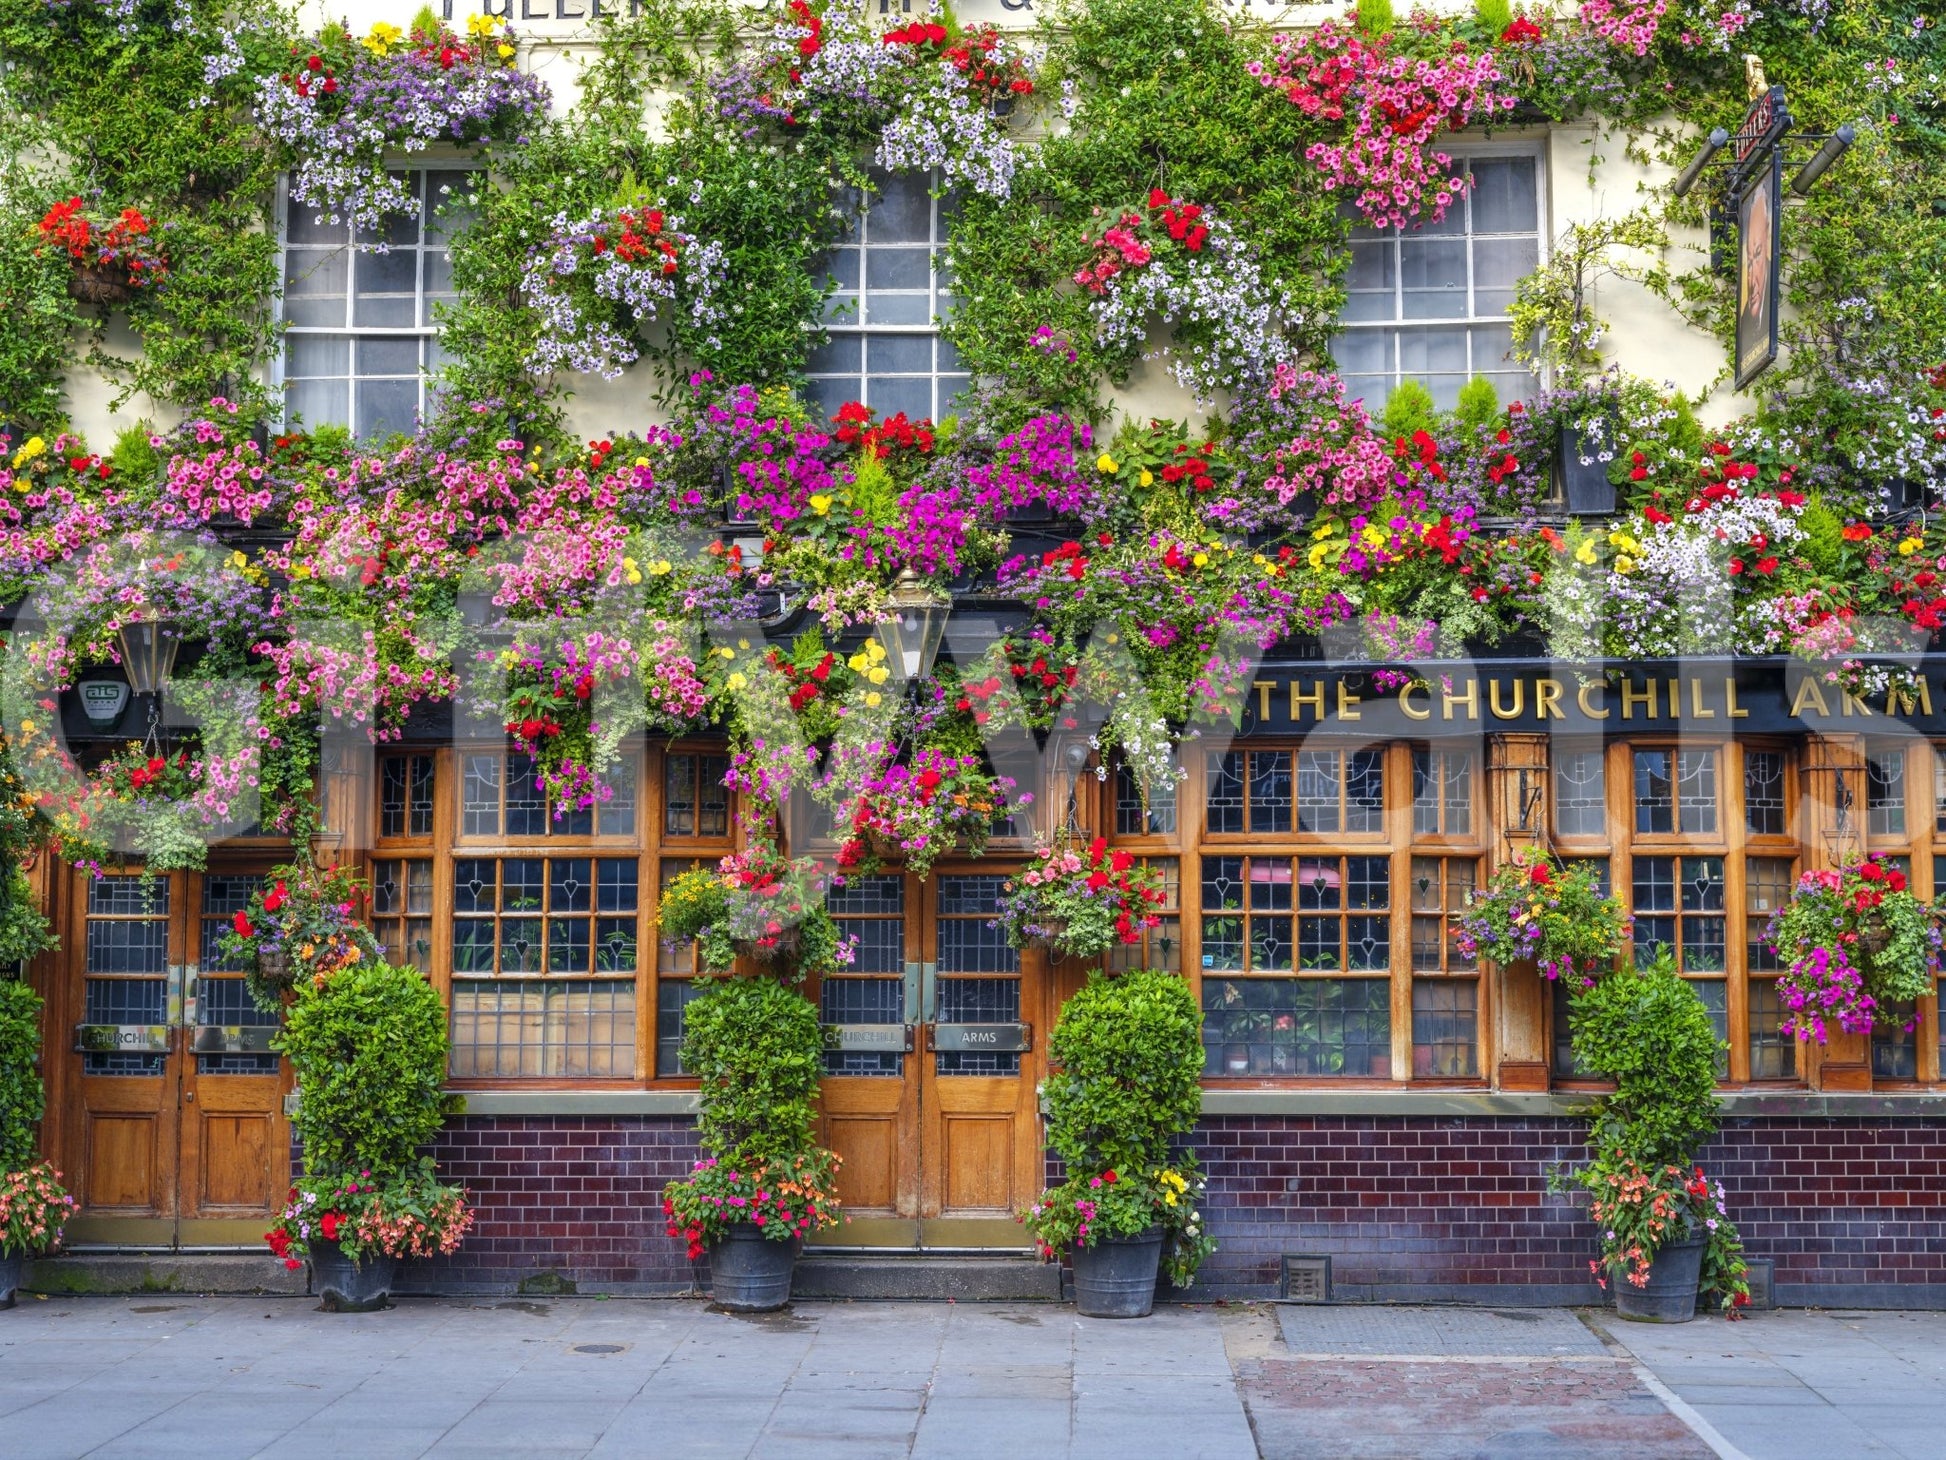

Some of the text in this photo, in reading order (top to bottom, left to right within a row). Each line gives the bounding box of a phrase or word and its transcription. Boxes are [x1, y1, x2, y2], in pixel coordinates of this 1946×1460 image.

[1253, 674, 1946, 721] THE CHURCHILL ARM
[825, 1031, 997, 1043] CHURCHILL ARMS
